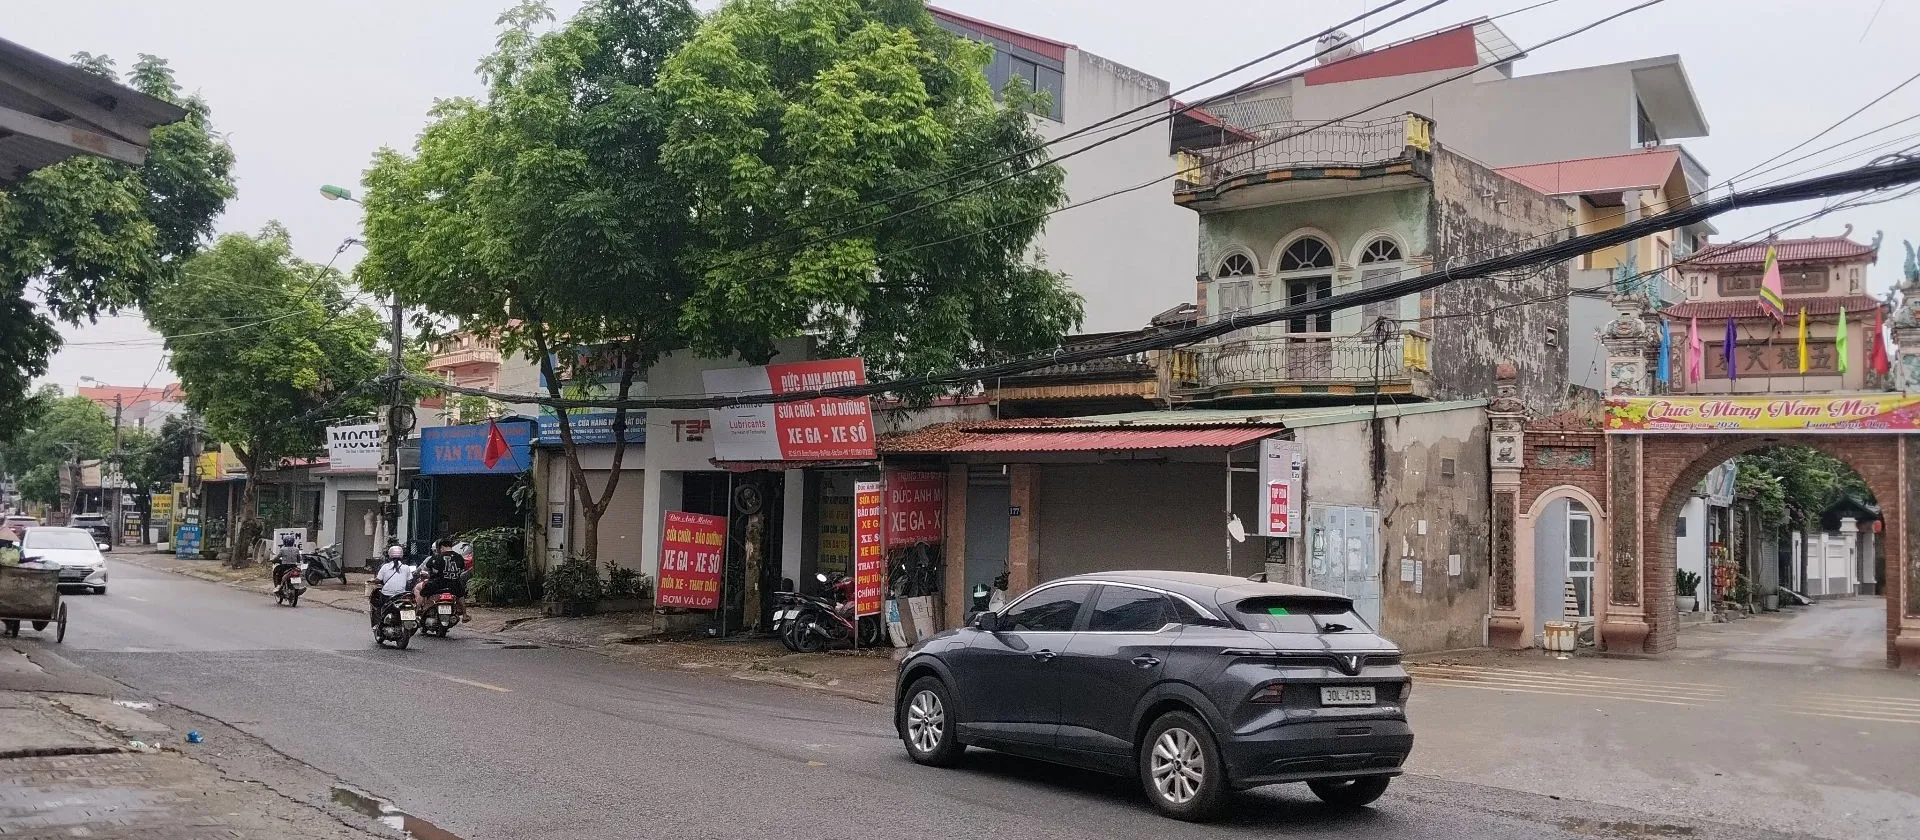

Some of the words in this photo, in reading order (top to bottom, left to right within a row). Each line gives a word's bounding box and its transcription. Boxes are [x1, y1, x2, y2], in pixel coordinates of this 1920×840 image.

[802, 373, 820, 391] ANH
[822, 371, 857, 390] MOTOR
[778, 403, 794, 418] SỬA
[794, 402, 815, 418] CHỮA
[821, 399, 837, 416] BẢO
[838, 400, 867, 415] DƯỠNG
[1648, 400, 1694, 419] Chúc
[729, 420, 766, 430] Lubricants
[1716, 421, 1740, 430] 2026
[788, 428, 802, 444] XE
[805, 427, 821, 444] GA
[831, 426, 848, 443] XE
[849, 420, 868, 442] SỐ
[892, 486, 912, 503] ĐỨC
[914, 489, 932, 503] ANH
[1010, 507, 1020, 515] 177
[862, 520, 871, 529] XE
[892, 511, 906, 532] XE
[909, 510, 925, 531] GA
[666, 525, 677, 541] SỬA
[861, 534, 872, 543] XE
[860, 547, 869, 557] XE
[663, 549, 676, 570] XE
[676, 551, 689, 571] GA
[695, 552, 707, 573] XE
[708, 547, 722, 573] SỐ
[858, 561, 875, 571] THAY
[674, 578, 684, 590] XE
[689, 579, 705, 592] THAY
[858, 575, 871, 586] PHỤ
[857, 586, 876, 598] CHÍNH
[662, 594, 682, 604] BƠM
[683, 594, 694, 605] VÁ
